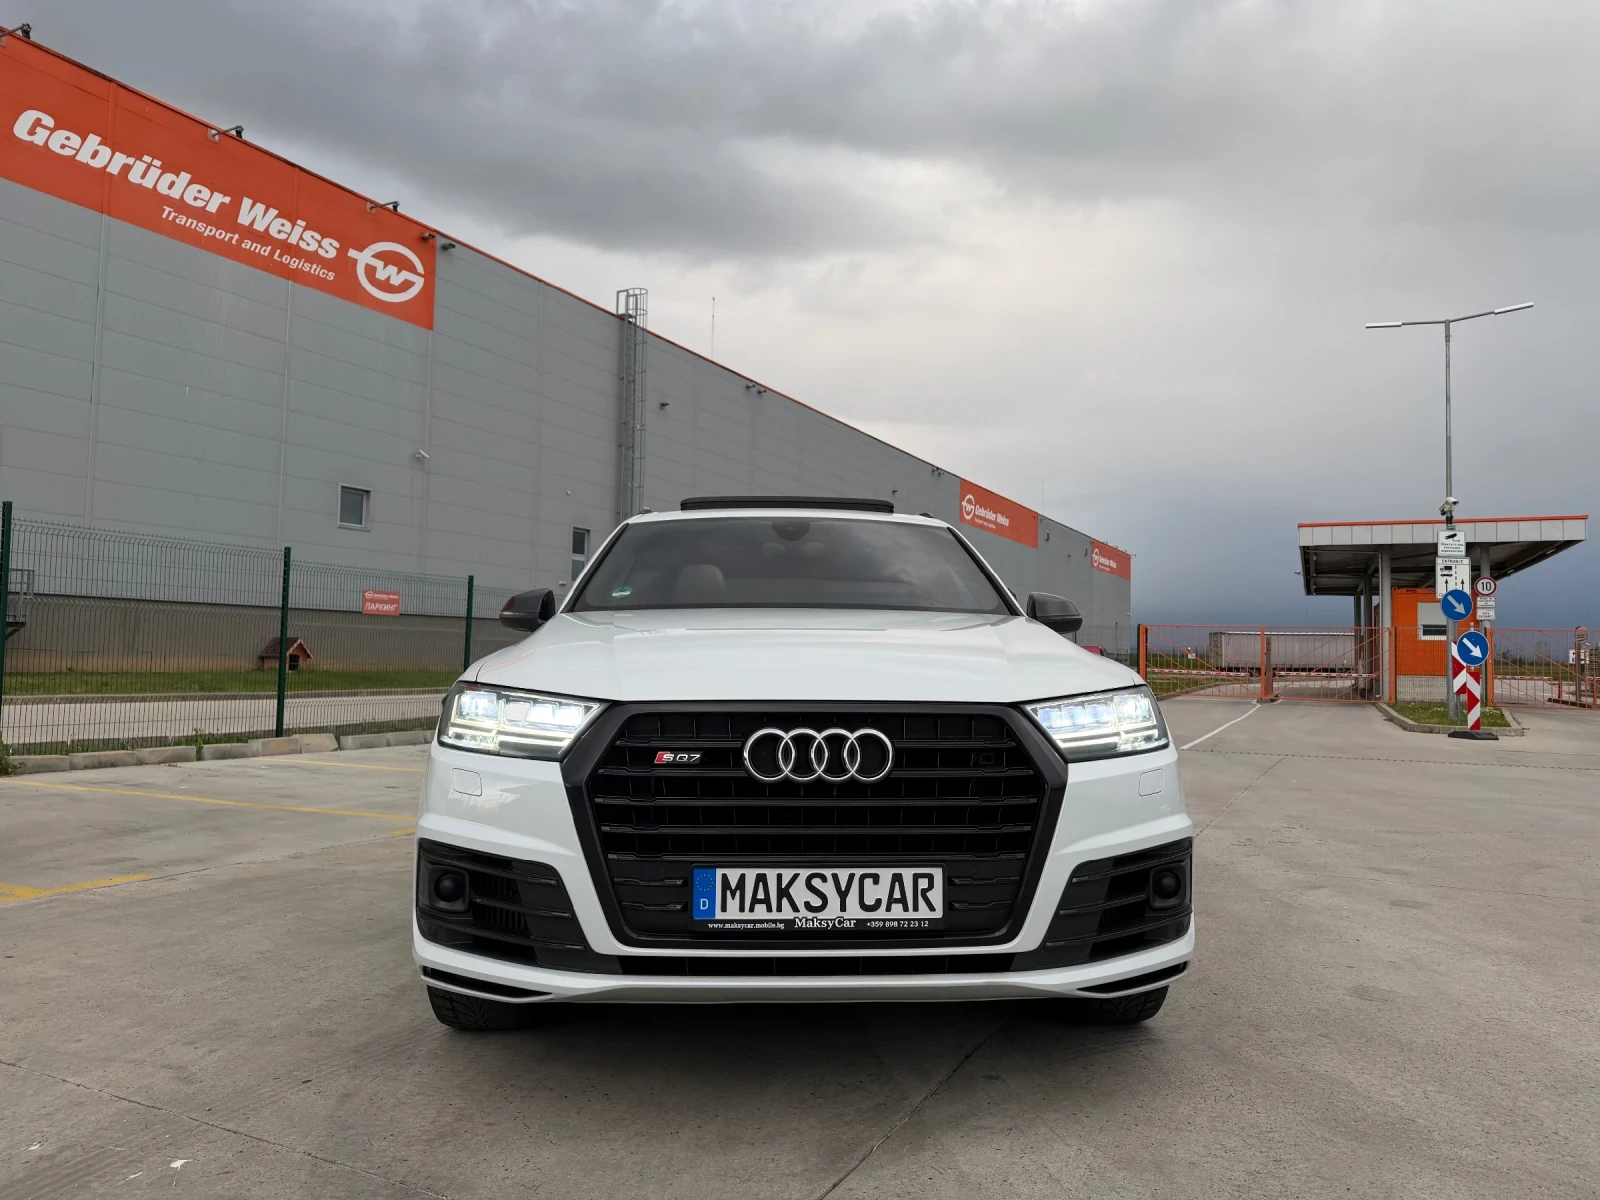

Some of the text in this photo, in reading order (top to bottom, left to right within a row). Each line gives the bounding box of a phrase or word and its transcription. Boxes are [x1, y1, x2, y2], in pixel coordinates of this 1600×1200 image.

[12, 109, 340, 259] Gebrüder Weiss
[160, 205, 336, 281] Transport and Logistics
[1481, 581, 1492, 591] 10
[365, 602, 398, 611] ПАРКИНГ
[659, 753, 701, 762] SQ7
[700, 872, 937, 914] D MAKSYCAR
[707, 922, 785, 930] www.maksycar.mobile.bg
[794, 917, 857, 929] MaksyCar
